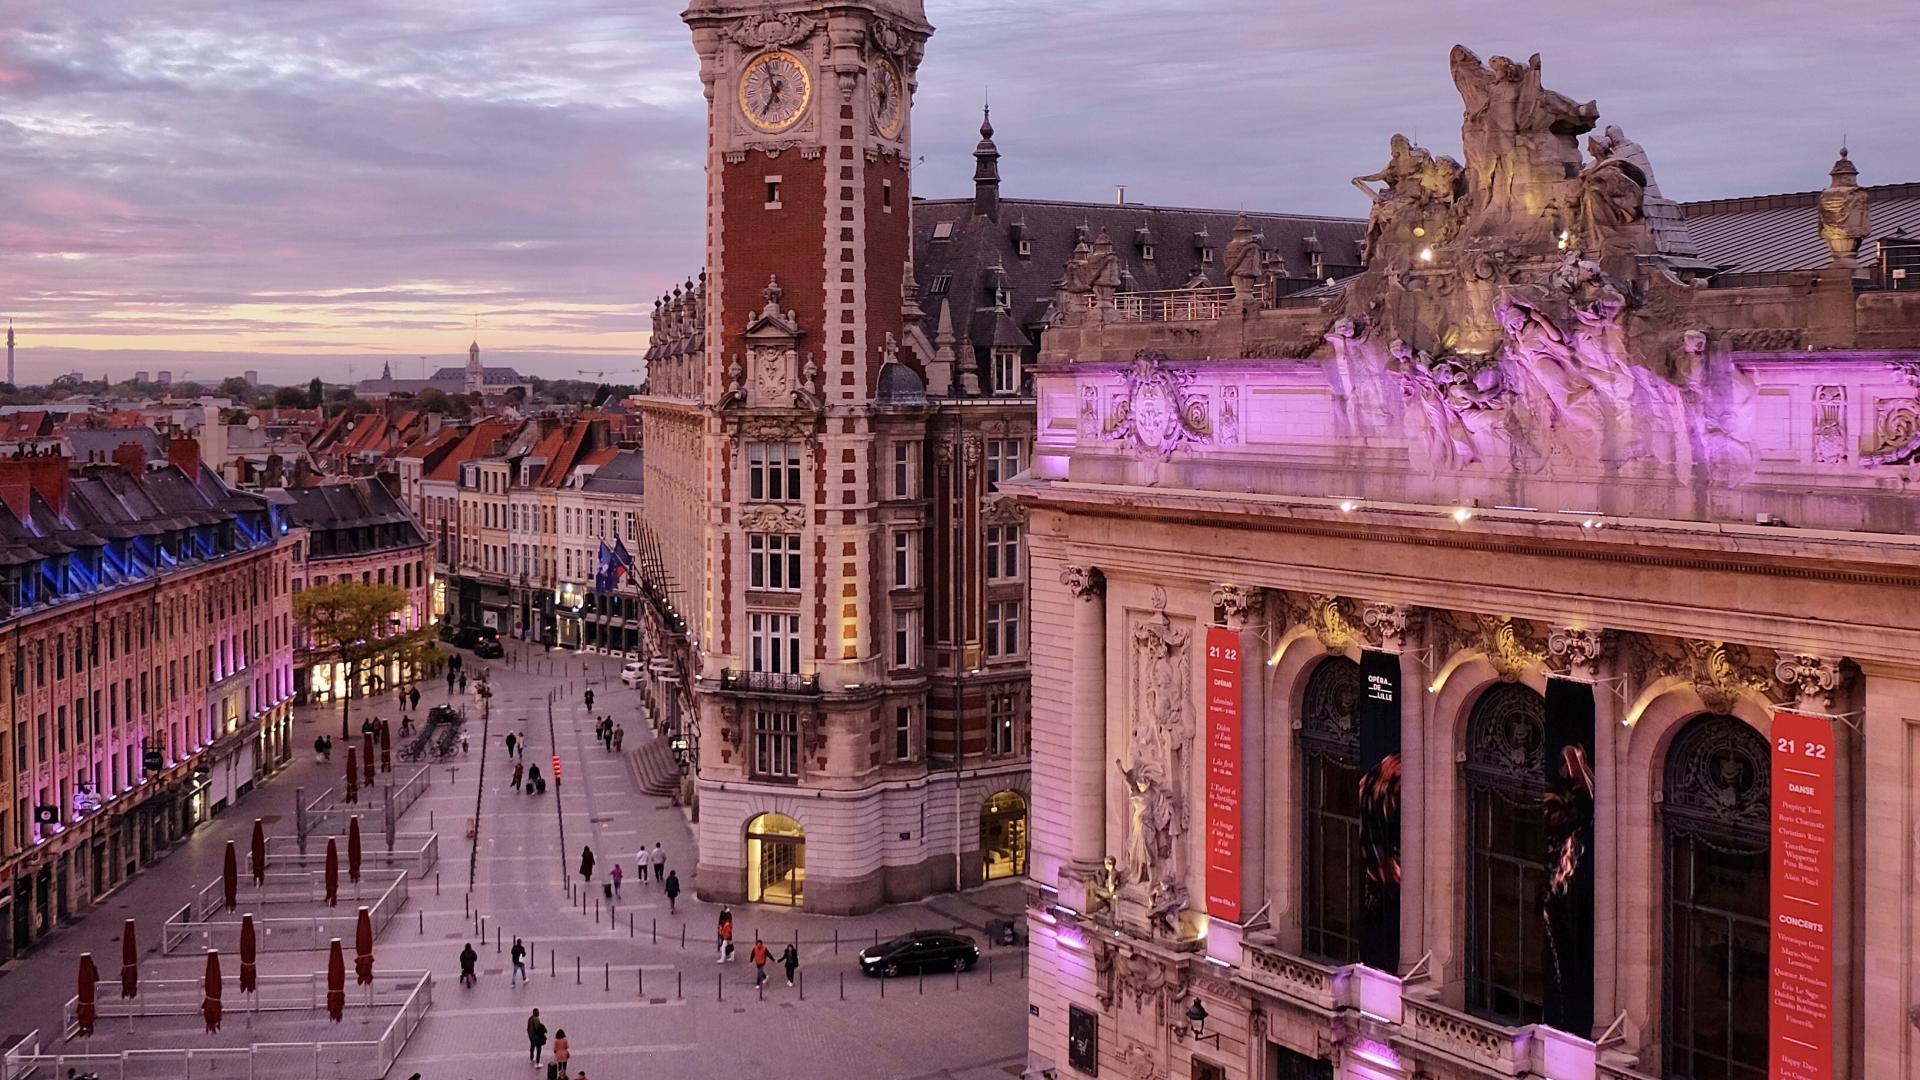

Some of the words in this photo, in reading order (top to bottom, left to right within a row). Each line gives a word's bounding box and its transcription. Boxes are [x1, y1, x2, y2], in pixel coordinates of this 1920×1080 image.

[1209, 646, 1220, 658] 21
[1224, 648, 1237, 661] 22
[1377, 692, 1392, 701] LILLE
[1777, 738, 1795, 754] 21
[1804, 742, 1826, 759] 22
[1788, 783, 1815, 796] DANSE
[1778, 814, 1794, 823] Boris
[1778, 827, 1807, 839] Christian
[1778, 914, 1824, 932] CONCERTS
